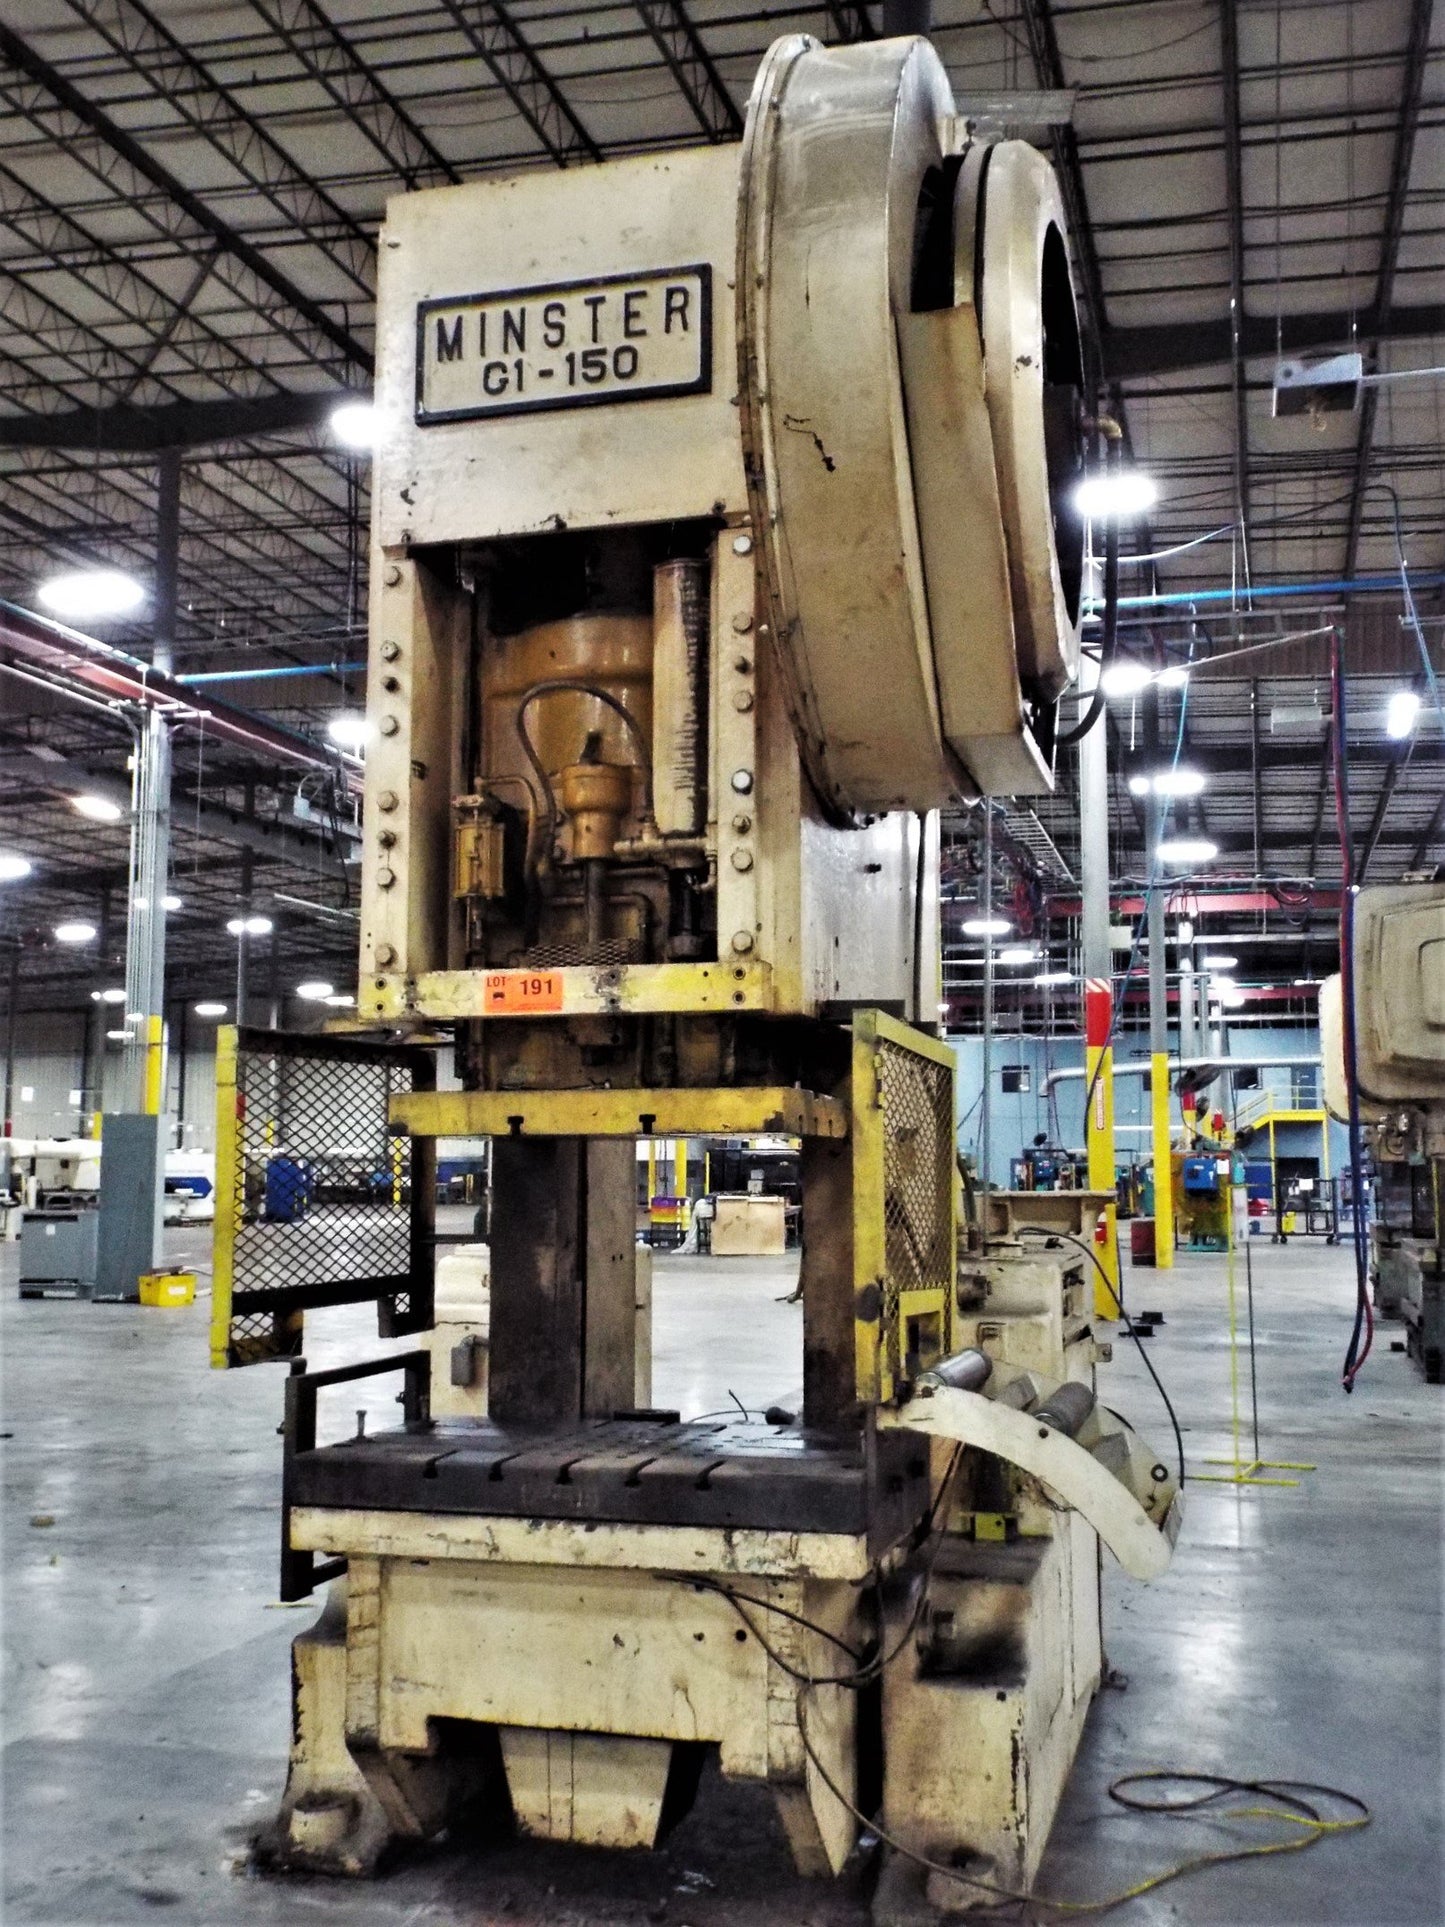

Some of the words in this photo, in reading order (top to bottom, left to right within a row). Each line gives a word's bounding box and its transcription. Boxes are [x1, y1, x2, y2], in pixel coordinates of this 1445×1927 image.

[437, 286, 689, 362] MINSTER
[487, 976, 506, 987] LOT
[520, 979, 552, 995] 191
